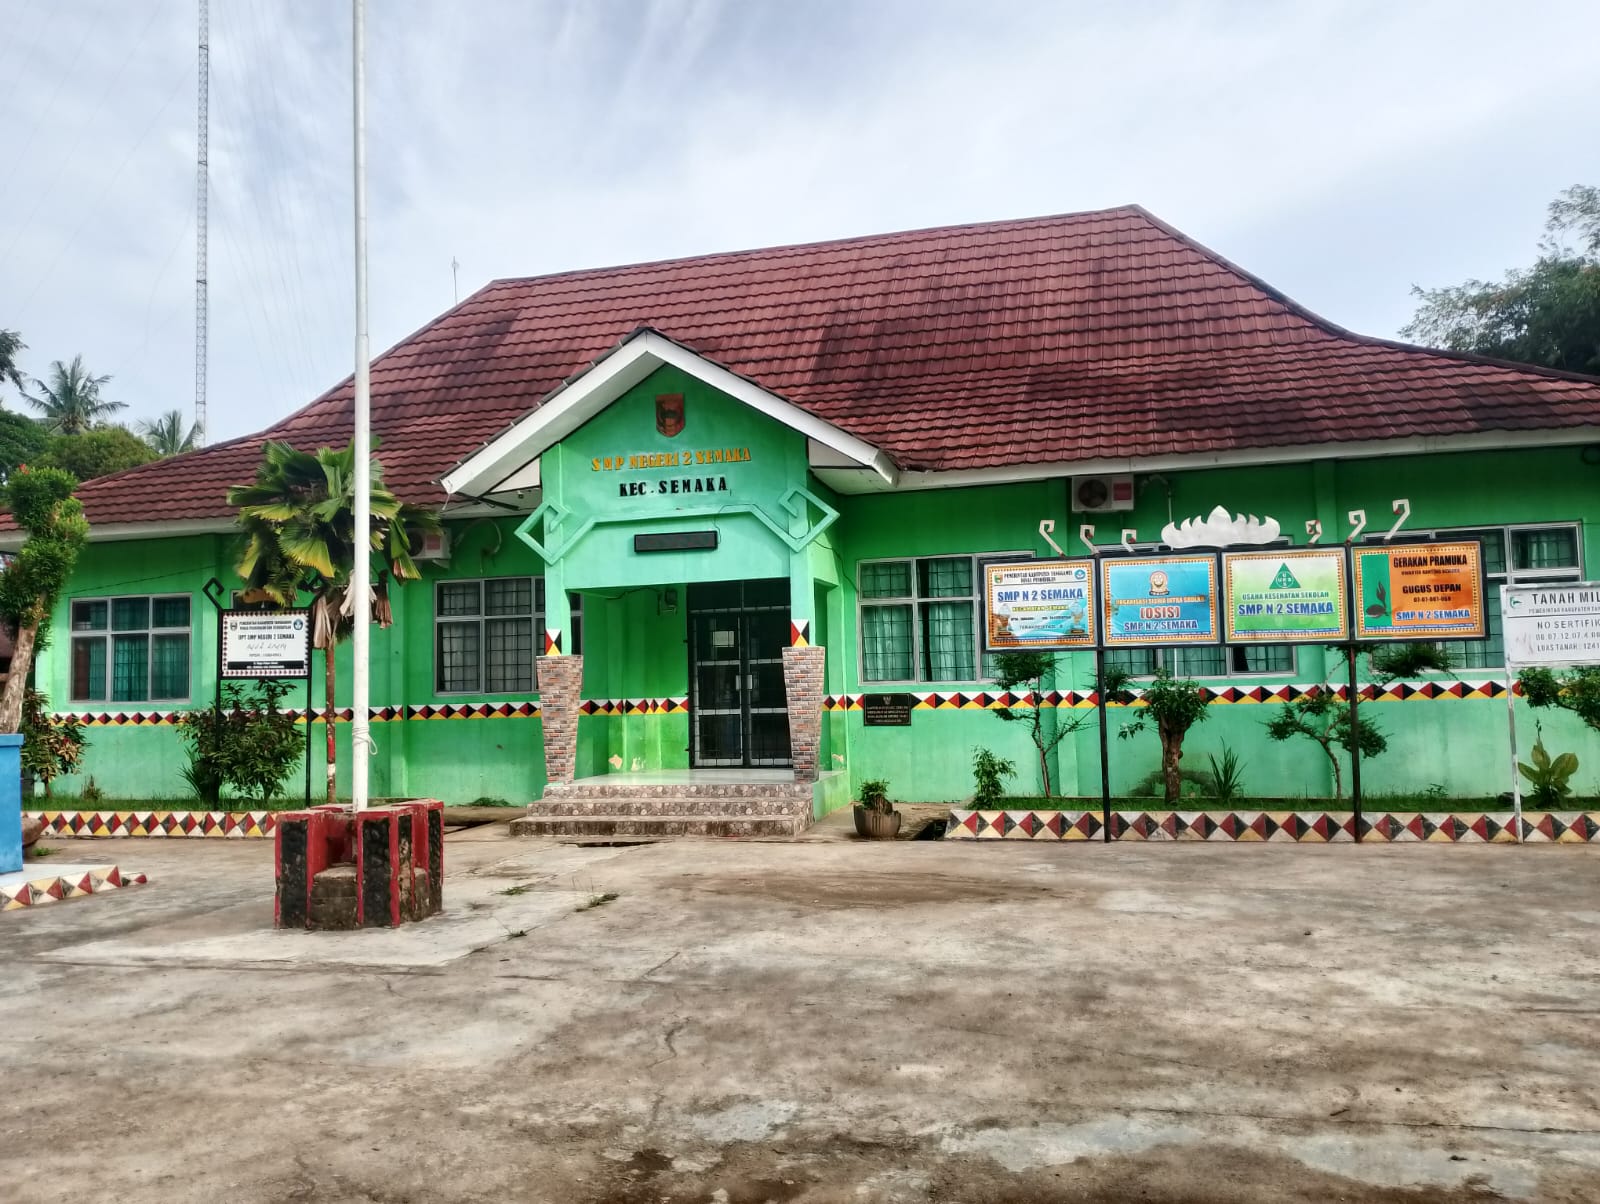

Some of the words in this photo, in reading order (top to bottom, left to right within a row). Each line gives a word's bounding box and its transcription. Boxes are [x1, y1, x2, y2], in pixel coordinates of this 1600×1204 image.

[592, 456, 624, 471] SMP
[628, 452, 679, 470] NEGERI
[683, 452, 692, 465] 2
[696, 447, 751, 464] SEMAKA
[658, 477, 727, 494] SEMAKA
[1393, 556, 1428, 568] GERAKAN
[1430, 555, 1467, 566] PRAMUKA
[998, 591, 1020, 601] SMP
[1023, 591, 1029, 601] N
[1032, 590, 1038, 600] 2
[1041, 588, 1083, 600] SEMAKA
[1402, 585, 1431, 594] GUGUS
[1434, 584, 1461, 592] DEPAN
[1532, 592, 1575, 604] TANAH
[1140, 606, 1180, 619] (OSIS)
[1239, 604, 1263, 615] SMP
[1266, 604, 1273, 614] N
[1277, 604, 1283, 614] 2
[1286, 602, 1333, 614] SEMAKA
[1396, 611, 1416, 620] SMP
[1426, 611, 1431, 619] 2
[1434, 610, 1470, 619] SEMAKA
[1124, 622, 1144, 631] SMP
[1146, 621, 1151, 630] N
[1153, 621, 1159, 630] 2
[1161, 620, 1198, 629] SEMAKA
[1537, 621, 1551, 629] NO
